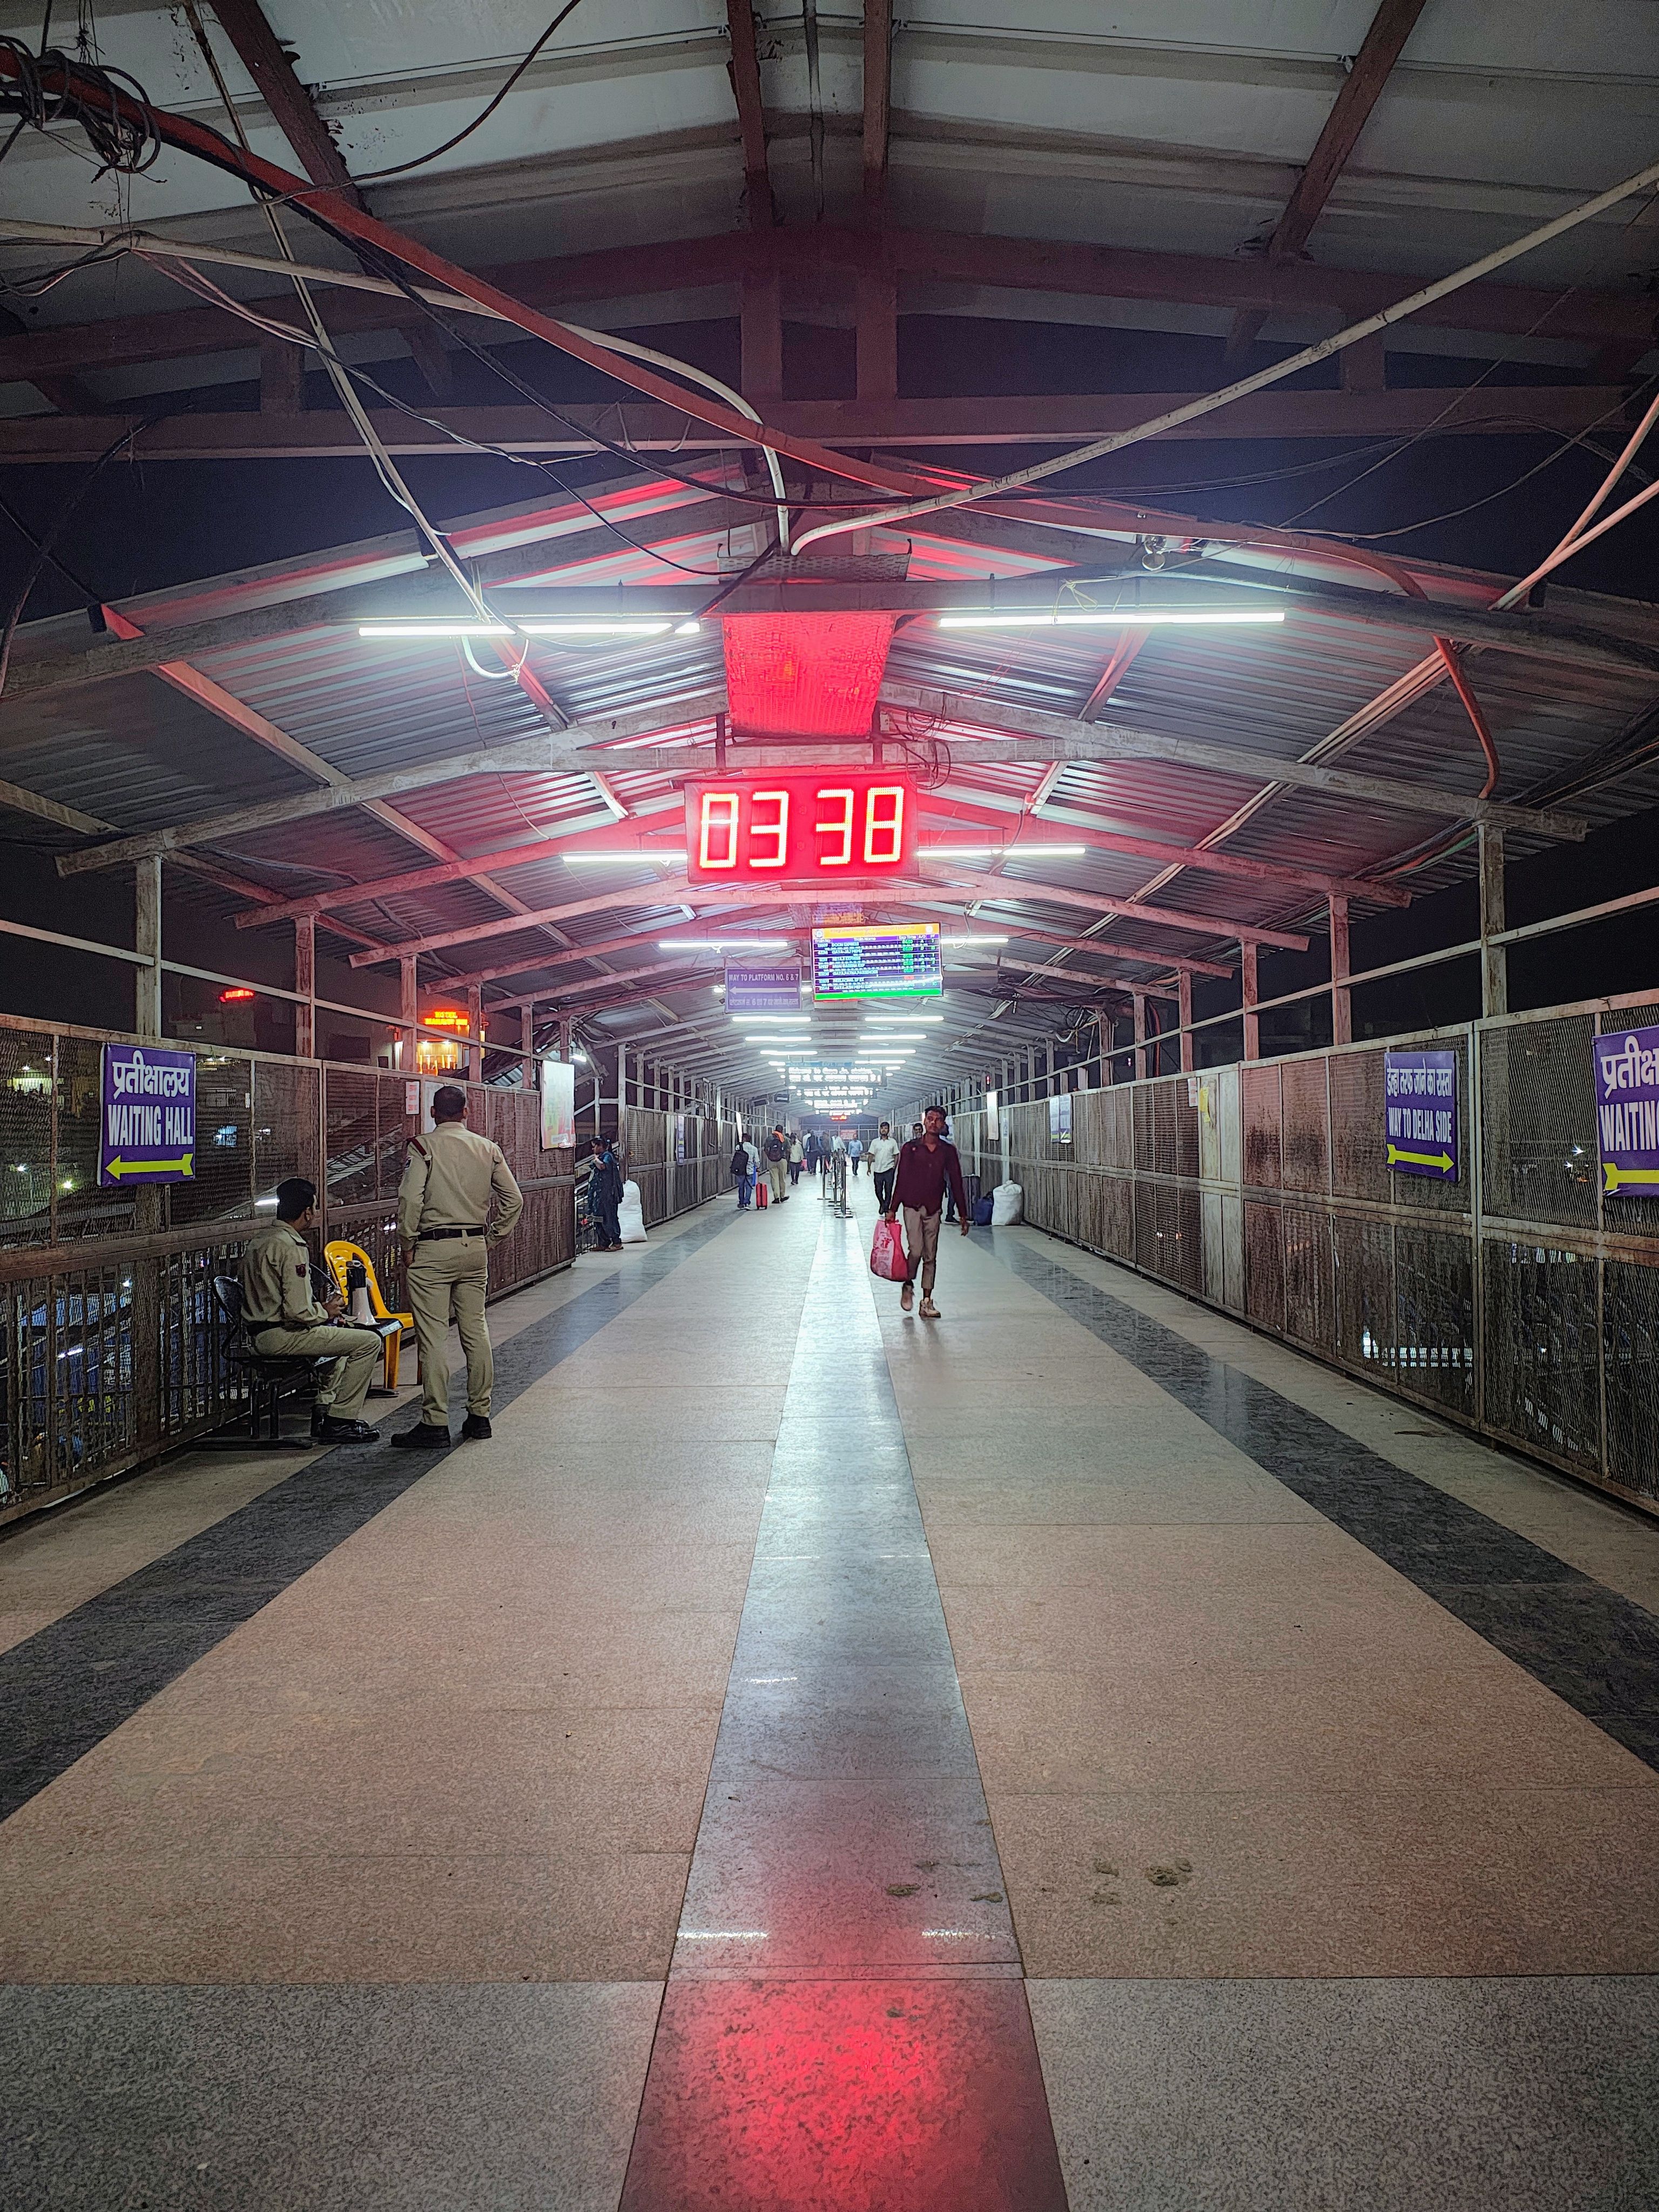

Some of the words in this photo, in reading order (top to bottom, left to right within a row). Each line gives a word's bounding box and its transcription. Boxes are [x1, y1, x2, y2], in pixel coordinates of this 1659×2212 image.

[112, 1050, 191, 1100] प्रतीक्षालय
[1427, 1068, 1435, 1096] का
[1437, 1068, 1452, 1097] रास्ता
[108, 1104, 161, 1146] WAITING
[165, 1107, 193, 1145] HALL
[1388, 1107, 1402, 1137] WAY
[1402, 1108, 1411, 1139] TO
[1413, 1109, 1434, 1142] DELHA
[1435, 1110, 1452, 1144] SIDE
[1600, 1100, 1659, 1152] WAITIN
